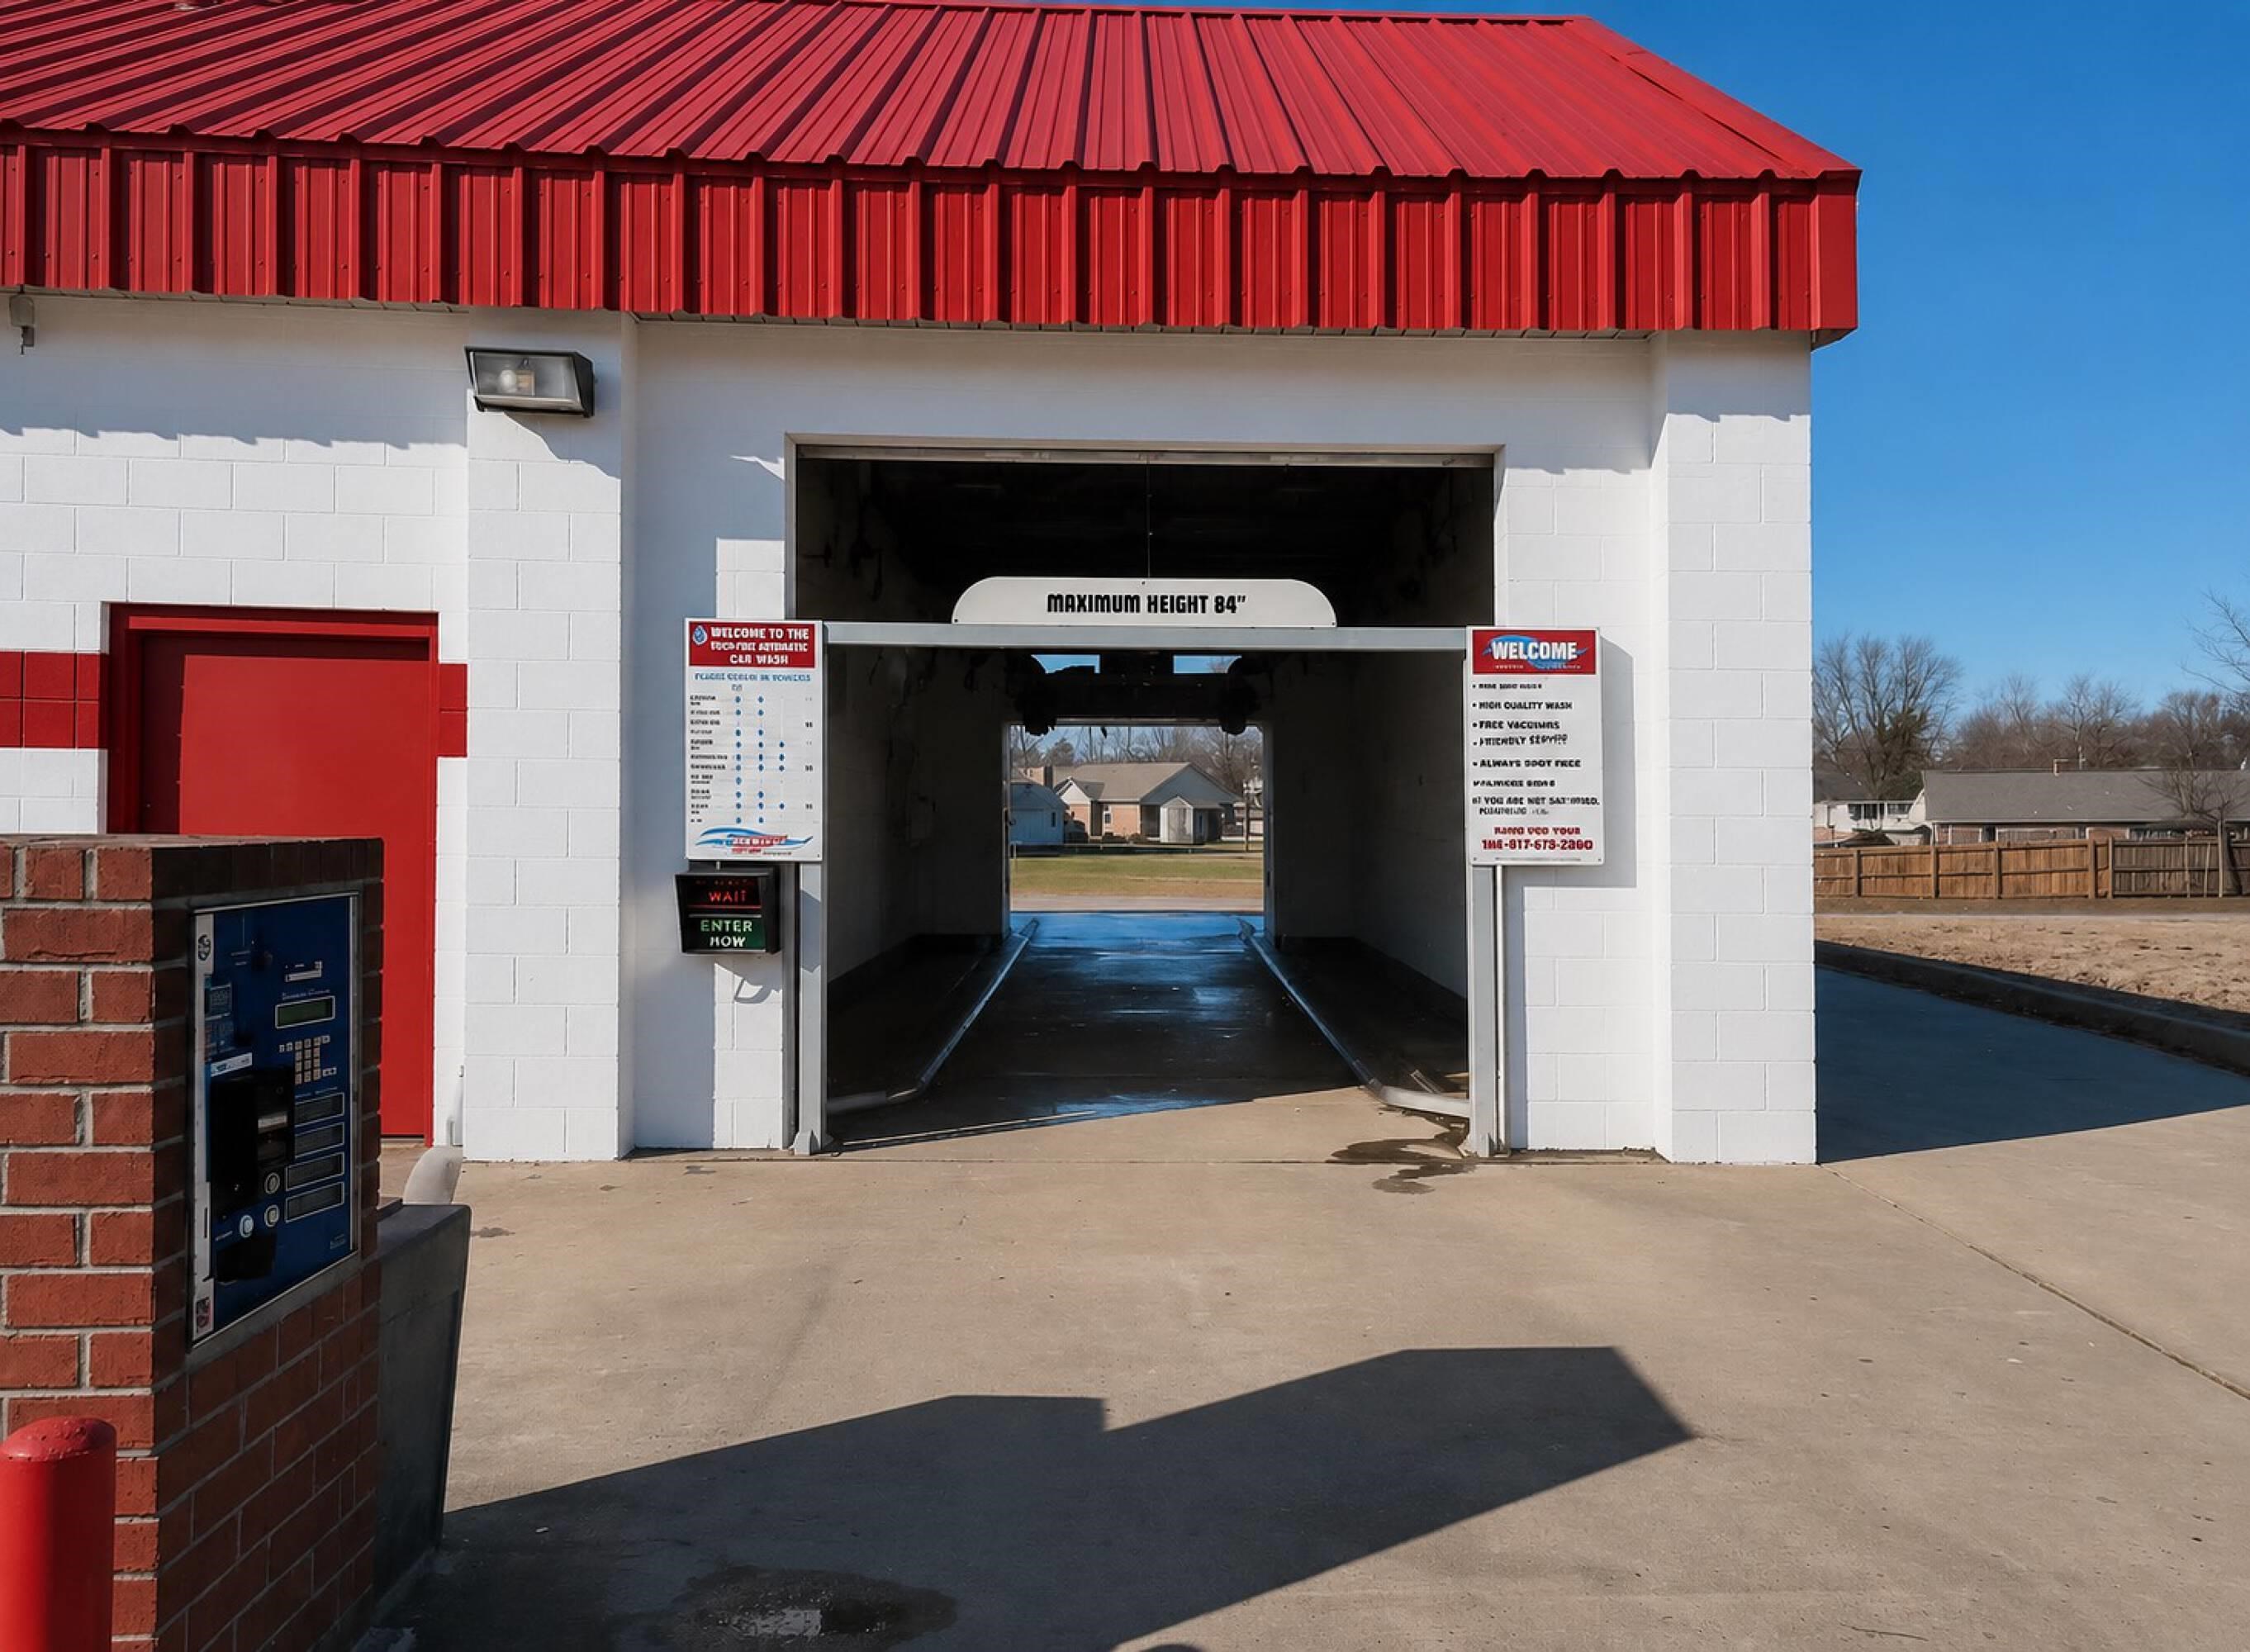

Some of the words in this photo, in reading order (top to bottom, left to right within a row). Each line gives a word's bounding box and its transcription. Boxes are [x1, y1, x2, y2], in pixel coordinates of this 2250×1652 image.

[1047, 593, 1141, 613] MAXIMUM
[1146, 594, 1209, 614] HEIGHT
[1213, 595, 1246, 614] 84"
[710, 626, 767, 638] WELCOME
[769, 628, 784, 638] TO
[786, 628, 809, 640] THE
[1491, 641, 1578, 660] WELCOME
[756, 654, 789, 665] WASH
[1504, 701, 1544, 710] QUALITY
[1545, 701, 1573, 710] WASH
[708, 890, 747, 903] WAIT
[700, 919, 752, 933] ENTER
